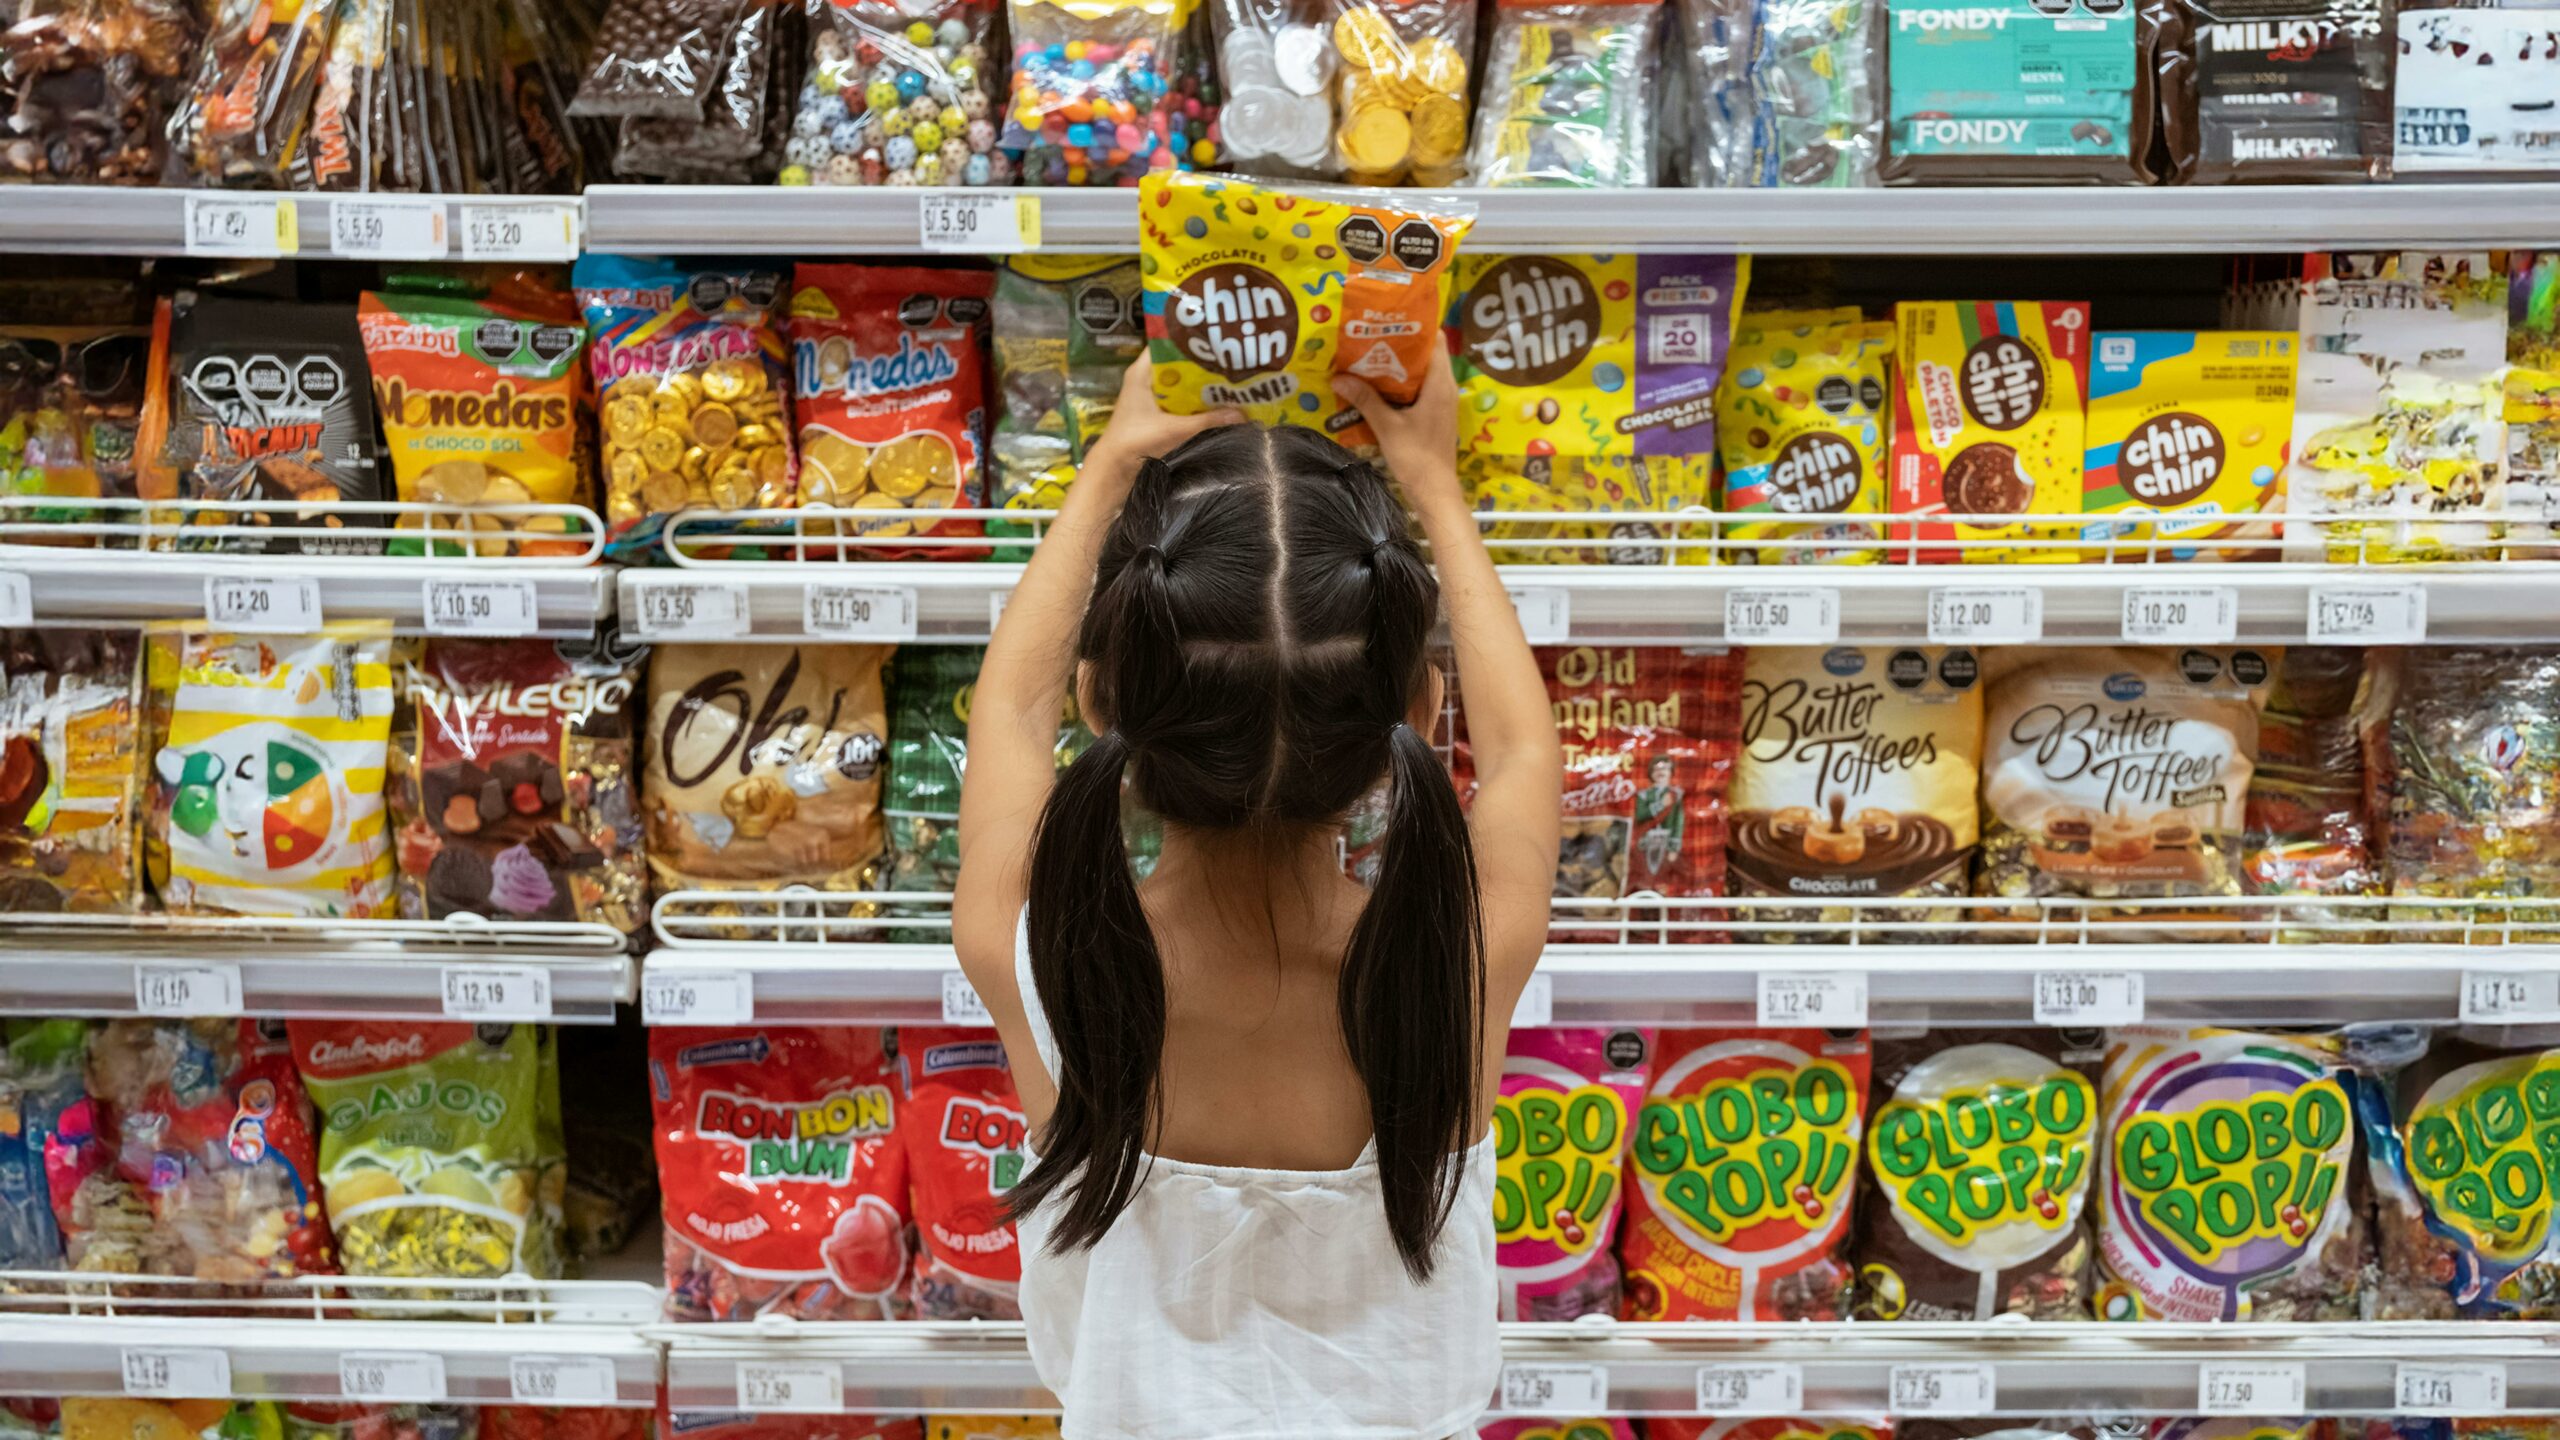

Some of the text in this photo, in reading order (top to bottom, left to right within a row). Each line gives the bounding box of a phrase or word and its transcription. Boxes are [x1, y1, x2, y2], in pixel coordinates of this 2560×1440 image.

[1898, 7, 2012, 32] FONDY
[2019, 72, 2065, 84] MENTA
[1914, 119, 2032, 145] FONDY
[1175, 249, 1268, 277] CHOCOLATES
[1400, 236, 1435, 247] ALTO EN
[1175, 273, 1287, 327] chin
[1472, 265, 1585, 329] chin
[1648, 289, 1712, 302] FIESTA
[1660, 274, 1703, 287] PACK
[1352, 324, 1414, 336] FIESTA
[1363, 308, 1408, 321] PACK
[1664, 330, 1698, 347] 20
[1672, 320, 1689, 329] DE
[1188, 320, 1288, 371] chin
[1481, 312, 1588, 371] chin
[1937, 370, 1961, 430] CHOCO
[1968, 351, 2007, 424] chin
[1997, 342, 2039, 421] chin
[1620, 396, 1713, 431] CHOCOLATE
[1672, 409, 1714, 430] REAL
[1775, 438, 1853, 487] chin
[2125, 418, 2215, 467] chin
[1779, 471, 1857, 513] chin
[2133, 452, 2217, 498] chin
[1556, 647, 1637, 688] Old
[1553, 690, 1681, 741] ngland
[1742, 677, 1885, 764] Butter
[2009, 703, 2185, 782] Butter
[1794, 728, 1938, 809] Toffees
[2089, 750, 2223, 814] Toffees
[1788, 876, 1878, 894] CHOCOLATE
[326, 1078, 508, 1133] GAJOS
[701, 1090, 890, 1141] BON BON
[1492, 1094, 1618, 1161] OBO
[1634, 1066, 1848, 1175] GLOBO
[1877, 1077, 2086, 1178] GLOBO
[750, 1141, 850, 1181] BUM
[2121, 1088, 2346, 1192] GLOBO
[1493, 1157, 1616, 1245] OP!!
[1664, 1131, 1850, 1234] POP!!
[1906, 1139, 2086, 1238] POP!!
[2150, 1152, 2340, 1256] POP!!
[723, 1212, 771, 1243] FRESA
[966, 1226, 1016, 1254] FRESA
[1685, 1250, 1741, 1291] CHICLE
[2169, 1276, 2223, 1306] SHAKE
